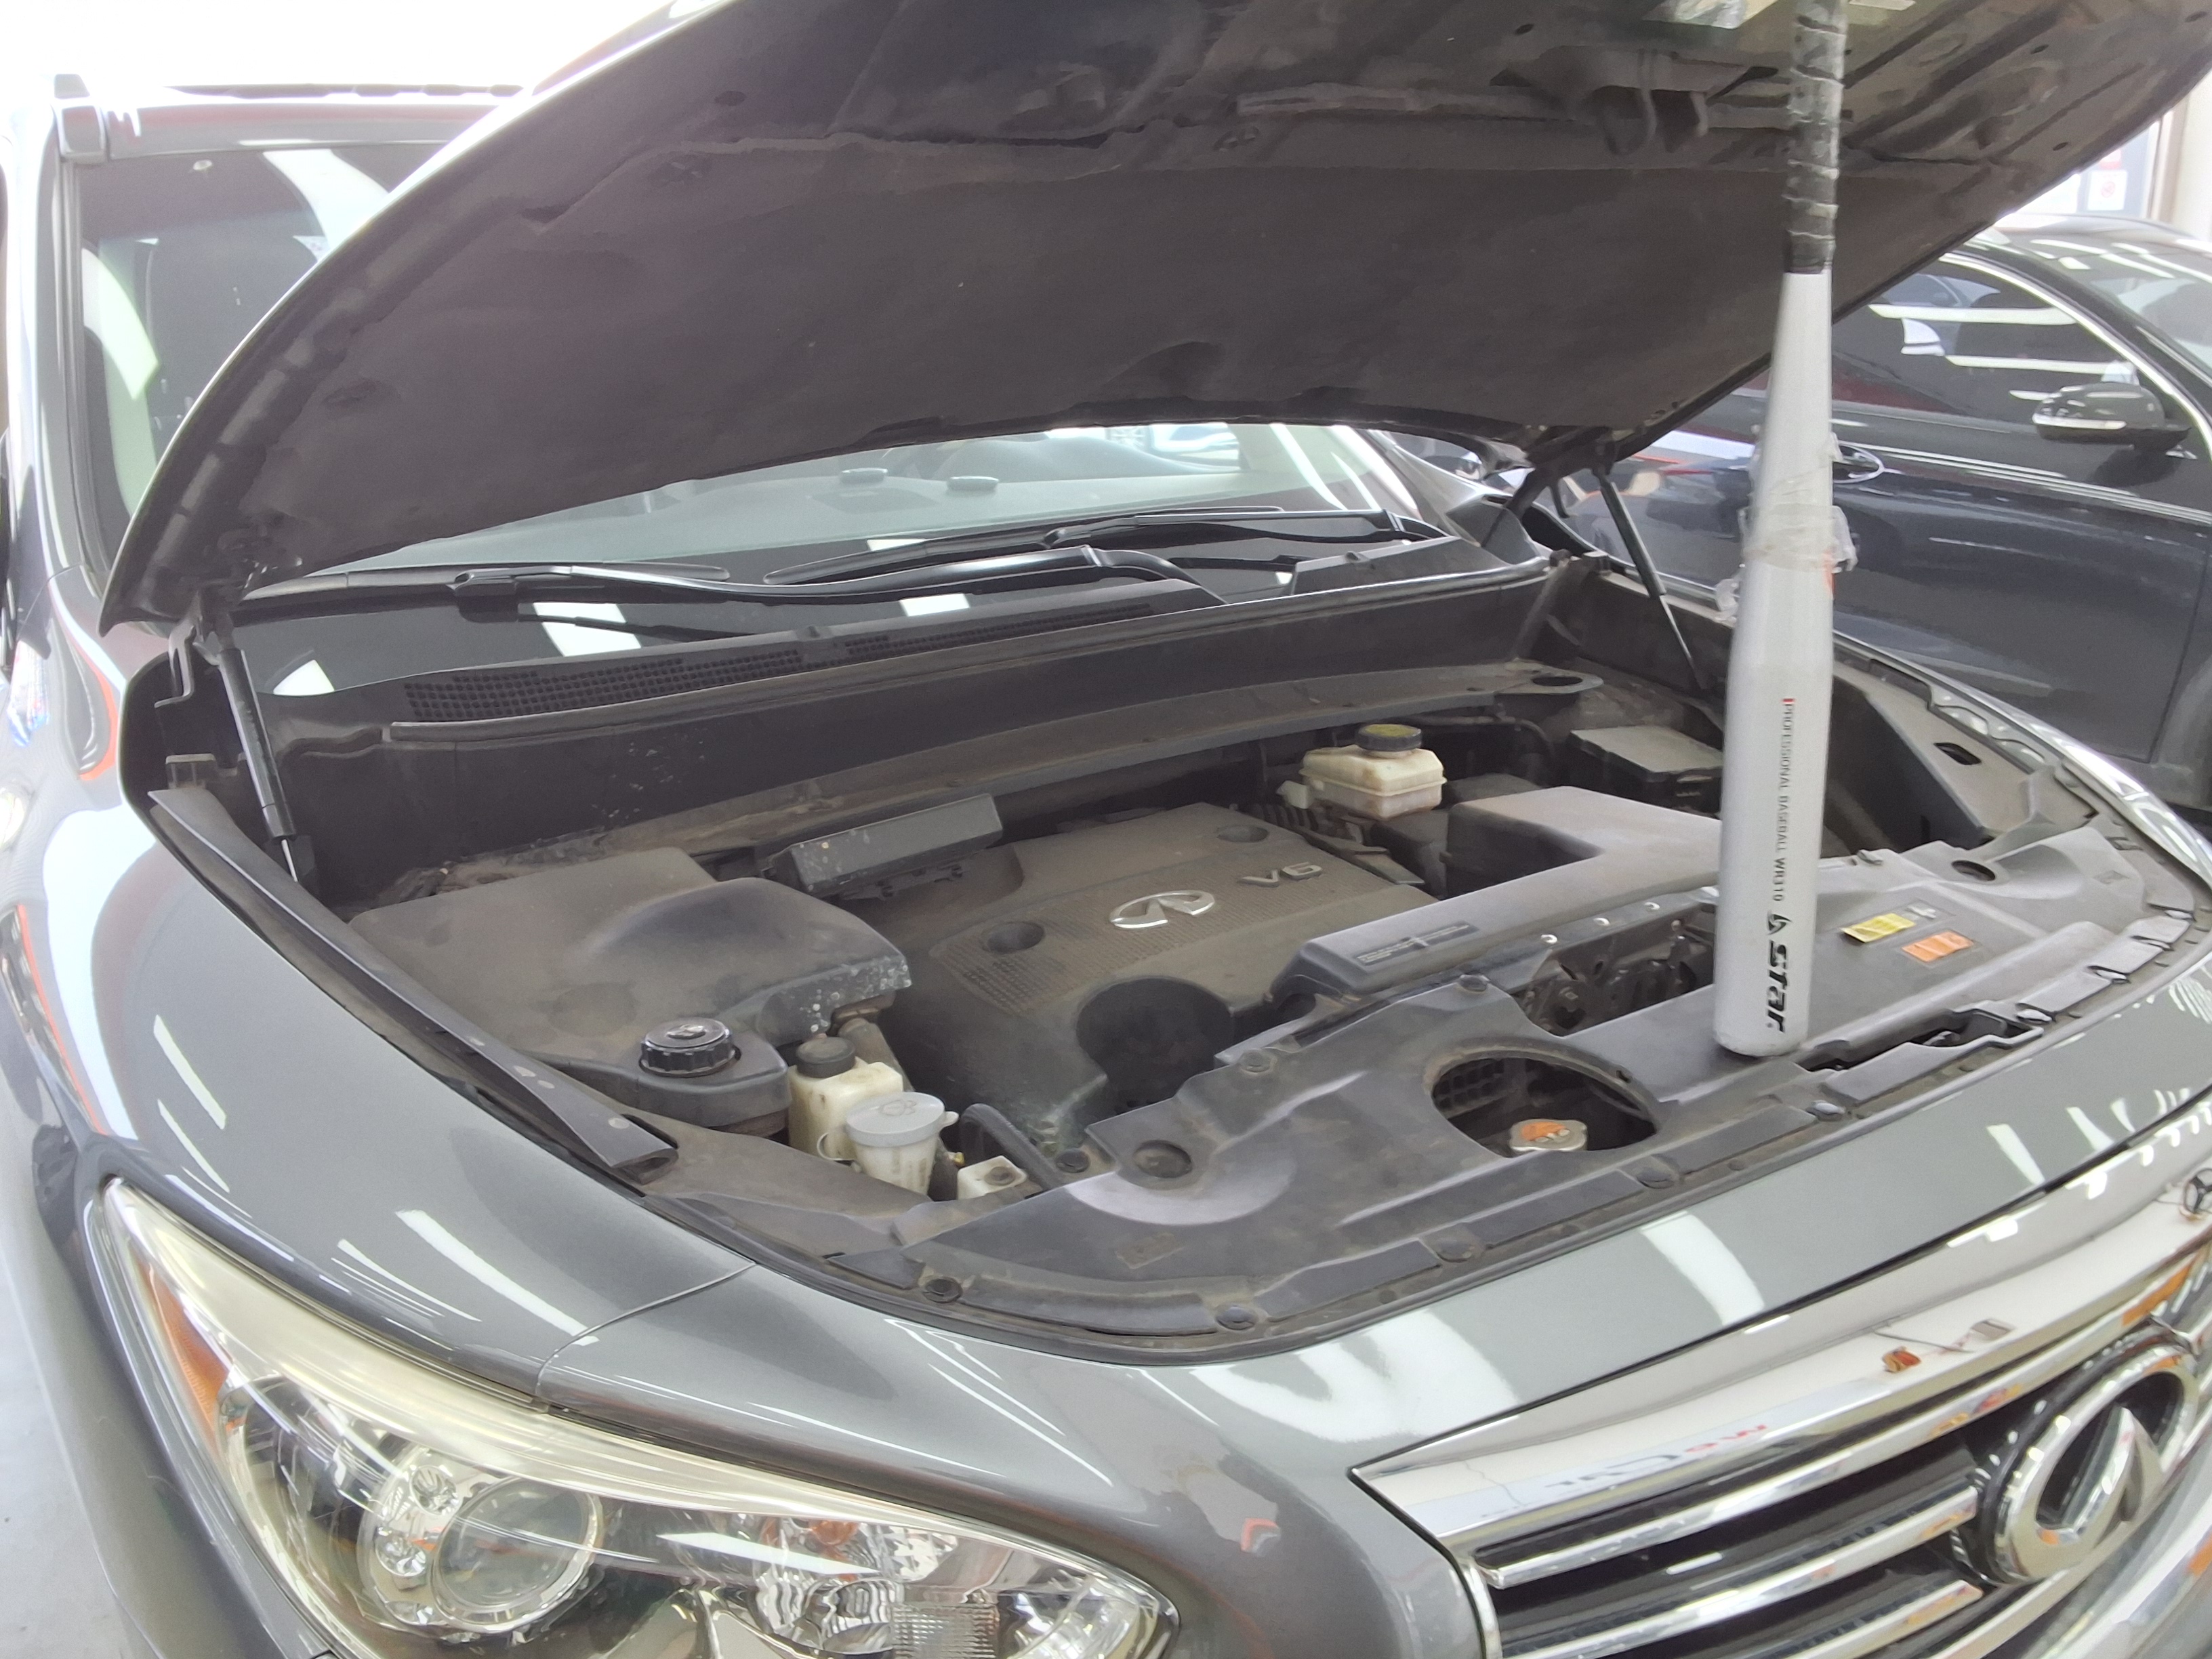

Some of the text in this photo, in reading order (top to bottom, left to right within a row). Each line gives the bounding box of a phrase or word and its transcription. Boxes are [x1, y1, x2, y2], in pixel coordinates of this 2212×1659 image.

[1778, 703, 1793, 791] PROFESSIONAL
[1776, 796, 1788, 853] BASEBALL
[1242, 861, 1323, 887] V6
